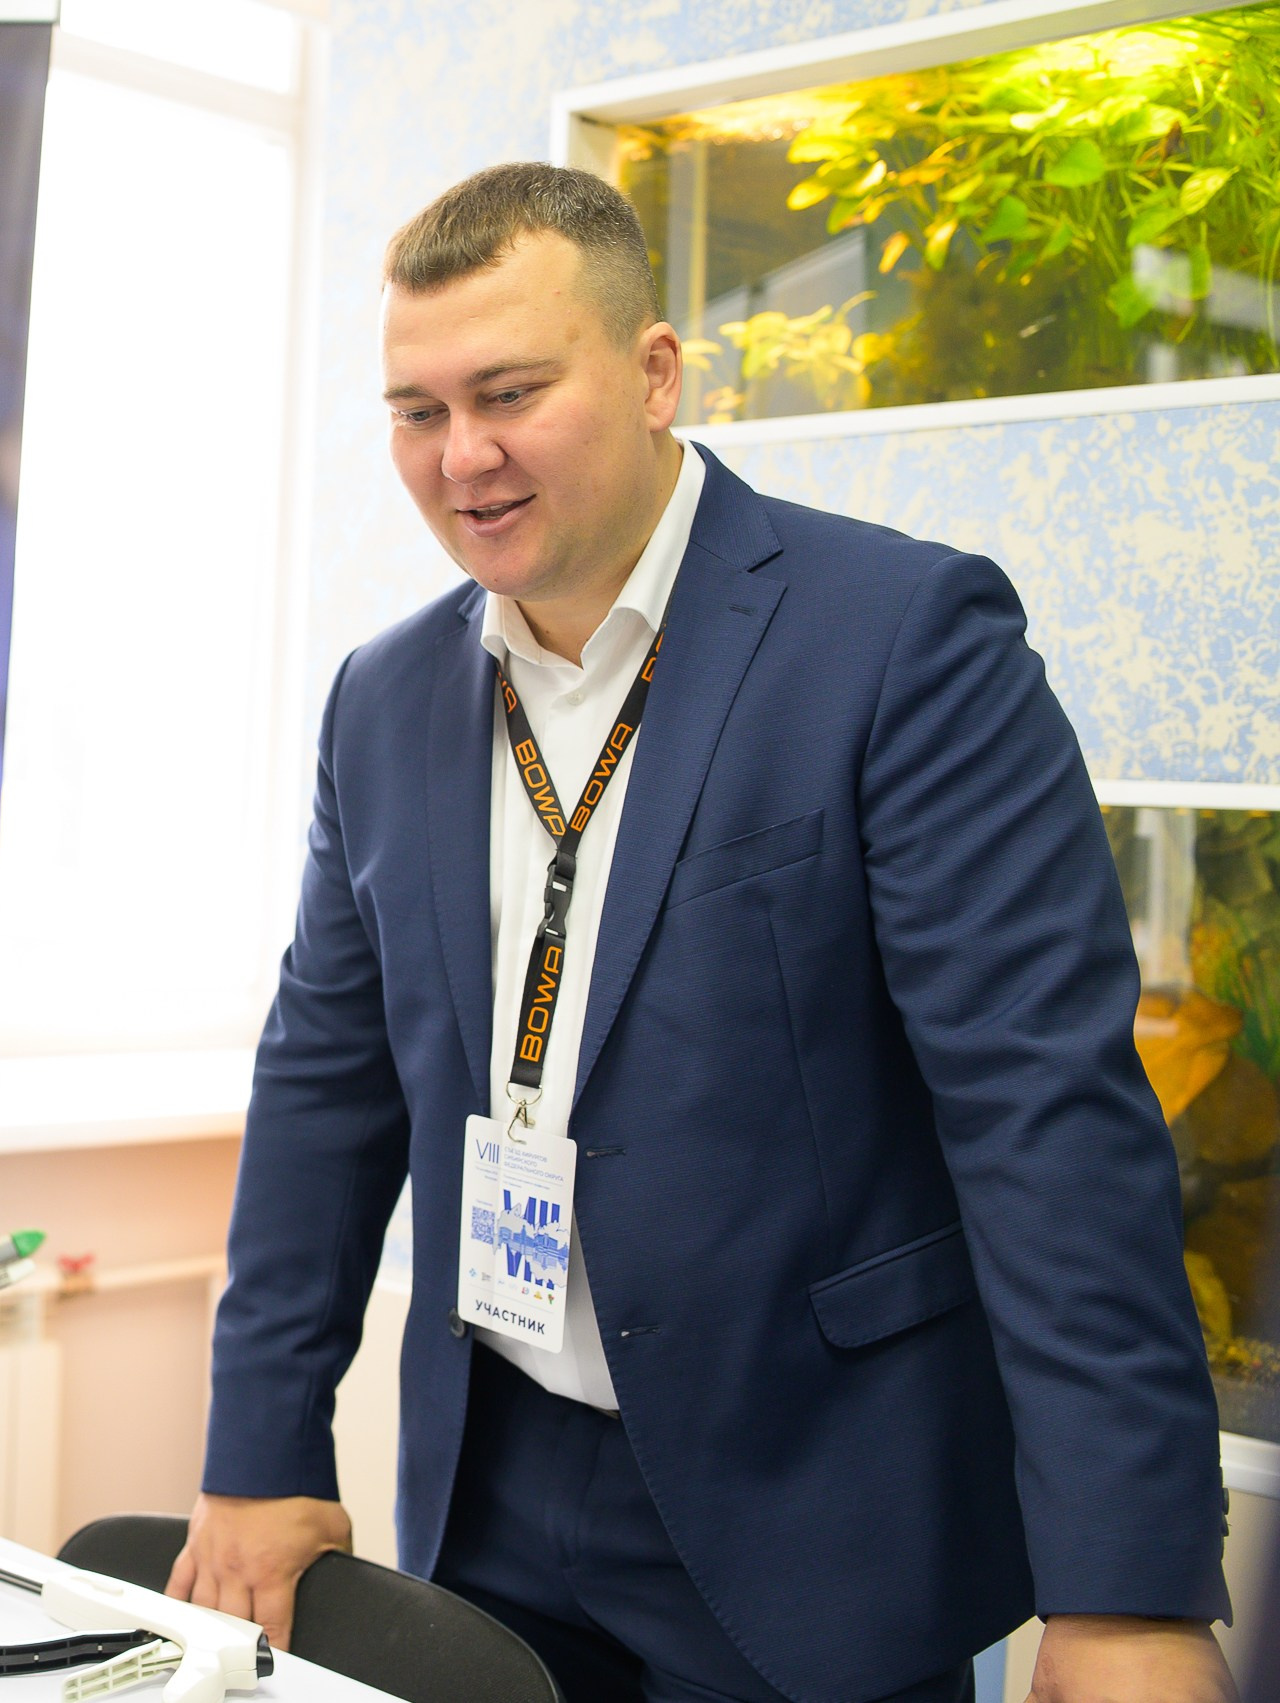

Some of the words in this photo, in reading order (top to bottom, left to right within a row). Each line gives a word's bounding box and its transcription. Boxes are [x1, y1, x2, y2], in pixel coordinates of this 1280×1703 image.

[515, 738, 566, 836] BOWA
[571, 723, 633, 832] BOWA
[519, 945, 562, 1063] BOWA
[475, 1138, 500, 1164] VIII
[475, 1299, 546, 1335] УЧАСТНИК
